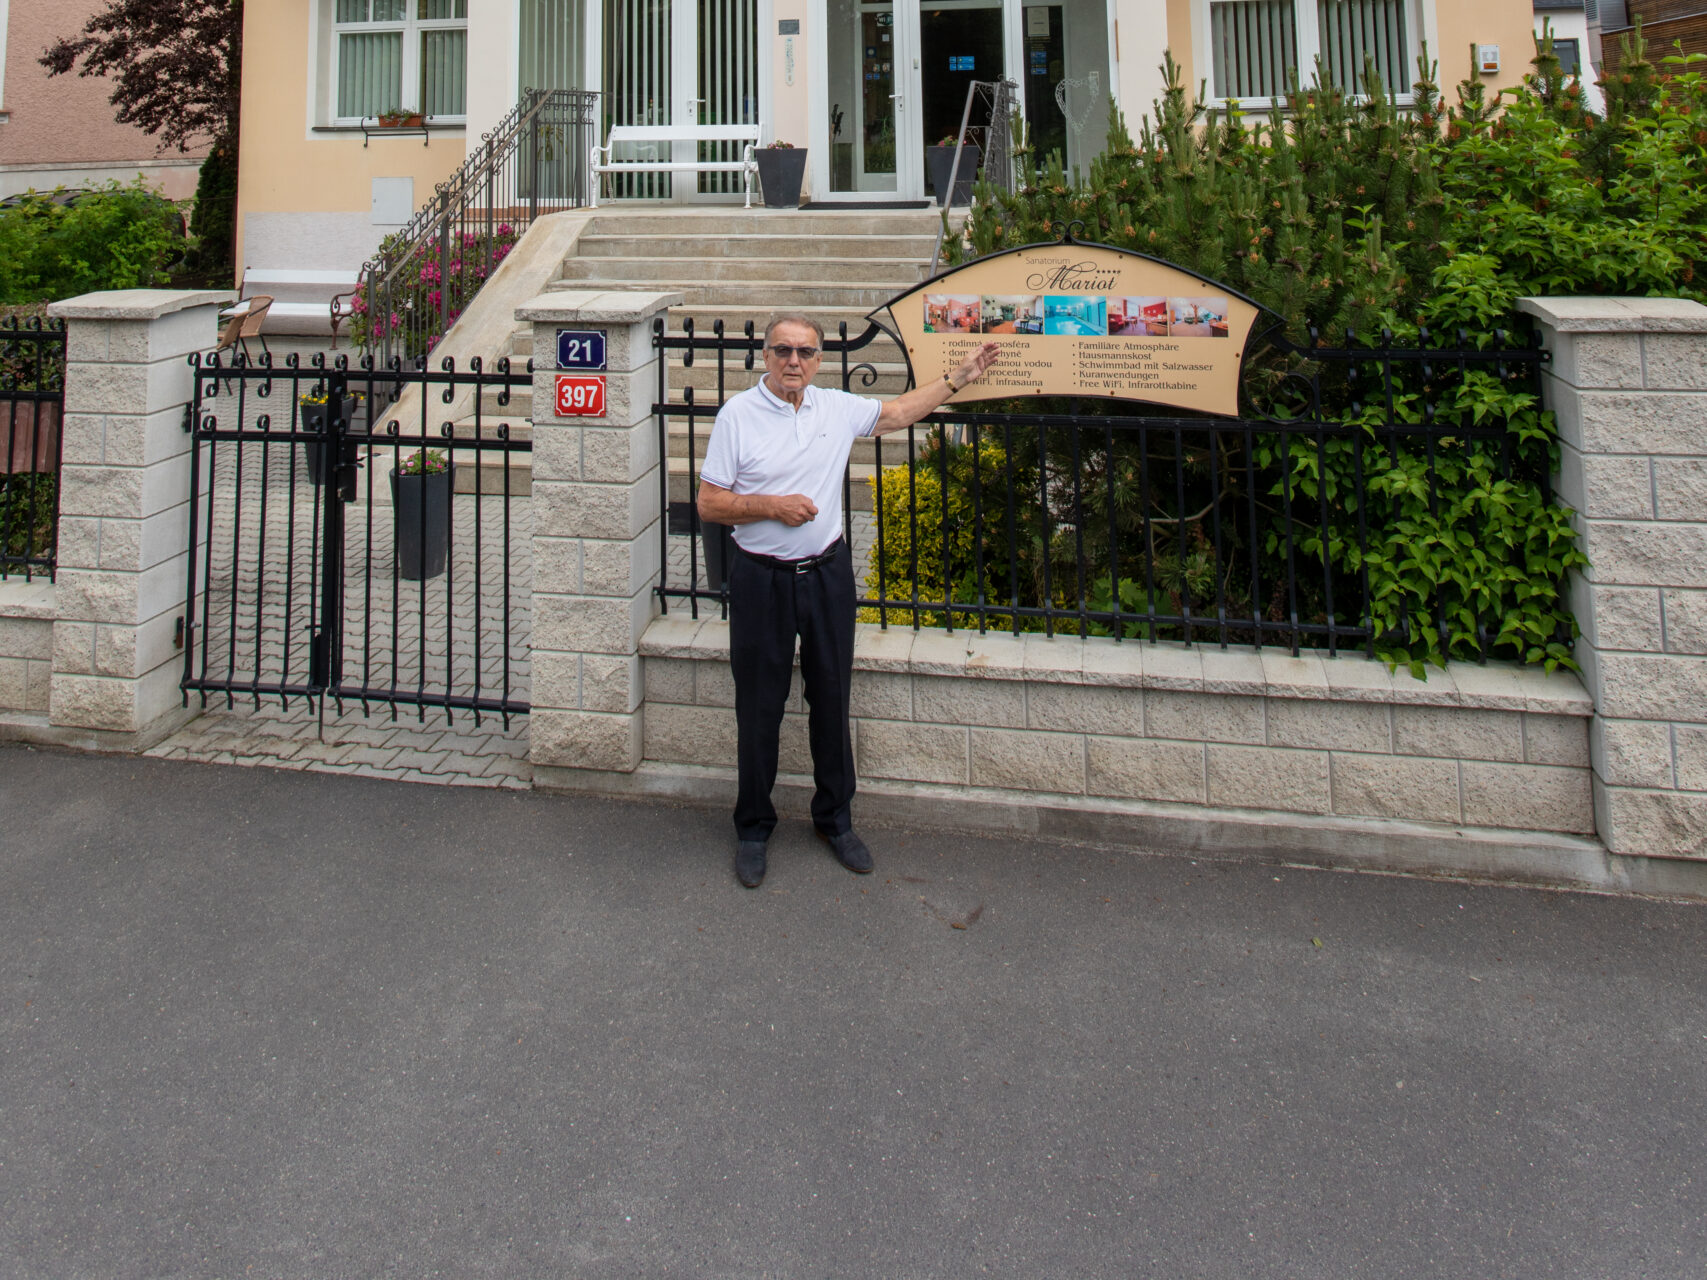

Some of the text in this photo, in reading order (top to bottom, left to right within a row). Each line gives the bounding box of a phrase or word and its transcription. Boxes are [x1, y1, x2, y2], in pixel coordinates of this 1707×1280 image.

[1025, 256, 1071, 265] Sanatorium
[1026, 261, 1117, 291] Mariot
[568, 339, 592, 362] 21
[1078, 341, 1180, 353] Familiäre Atmosphäre
[1078, 351, 1152, 360] Hausmannskost
[1023, 360, 1053, 368] vodou
[1078, 360, 1213, 371] Schwimmbad mit Salzwasser
[987, 368, 1032, 378] procedury
[1079, 370, 1159, 381] Kuranwendungen
[996, 378, 1043, 387] infrasauna
[1079, 380, 1099, 388] Free
[1128, 381, 1198, 390] Infrarottkabine
[561, 385, 598, 408] 397
